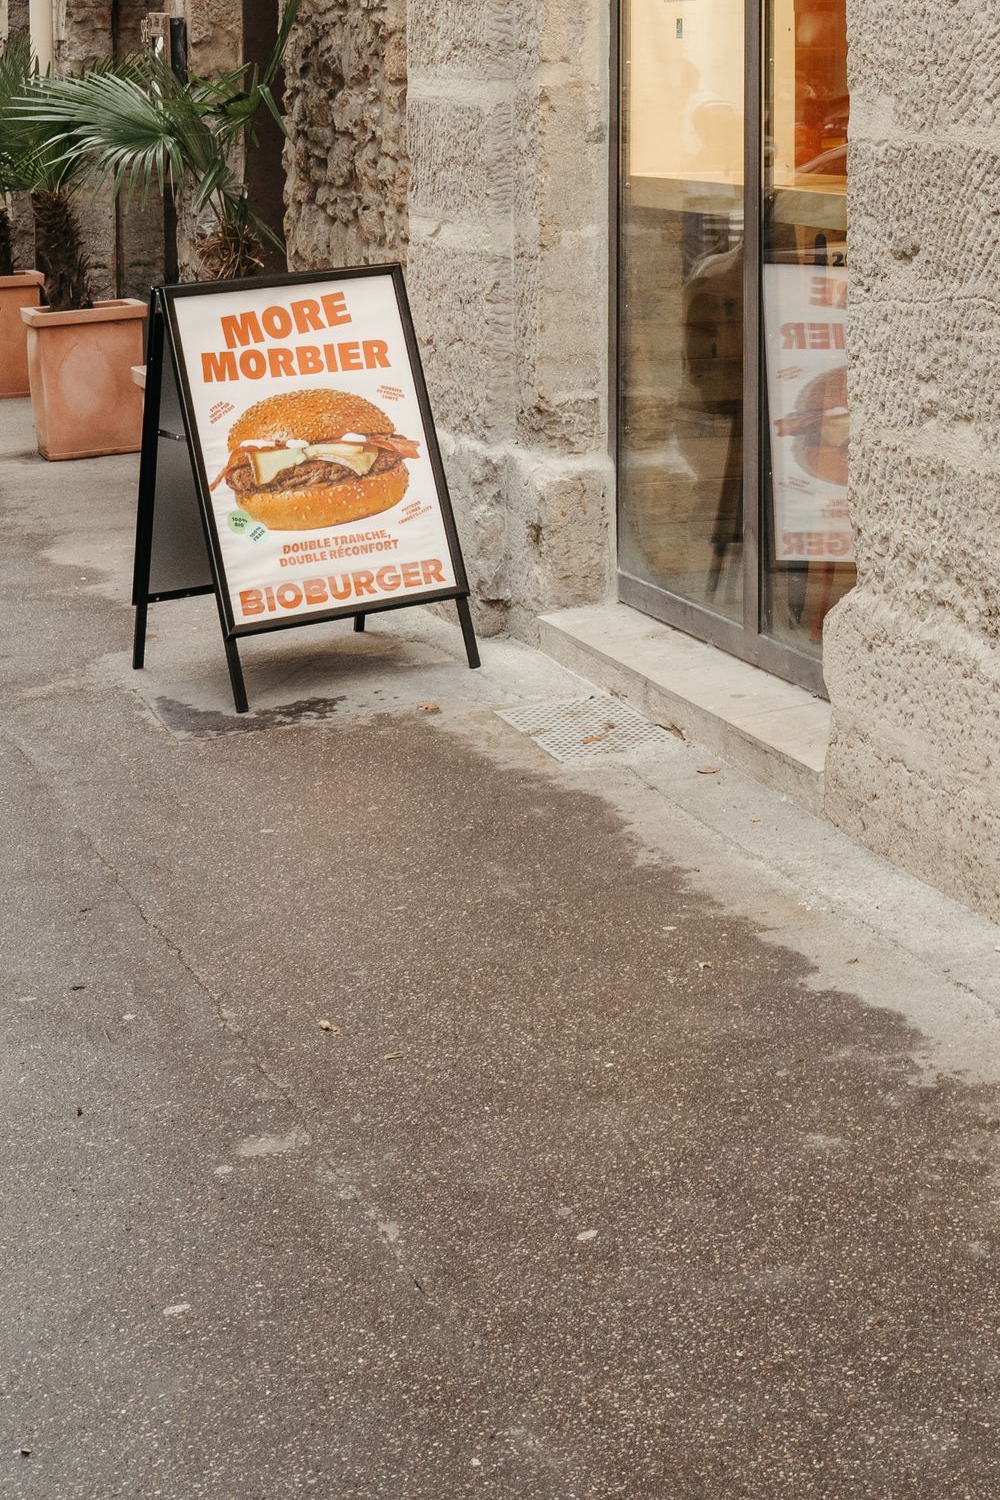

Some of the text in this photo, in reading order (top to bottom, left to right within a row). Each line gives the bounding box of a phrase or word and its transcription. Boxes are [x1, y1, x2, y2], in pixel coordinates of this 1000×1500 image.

[220, 291, 353, 350] MORE
[200, 339, 392, 383] MORBIER
[279, 539, 400, 568] DOUBLE RÉCONFORT
[282, 529, 391, 555] DOUBLE TRANCHE,
[239, 558, 447, 617] BIOBURGER
